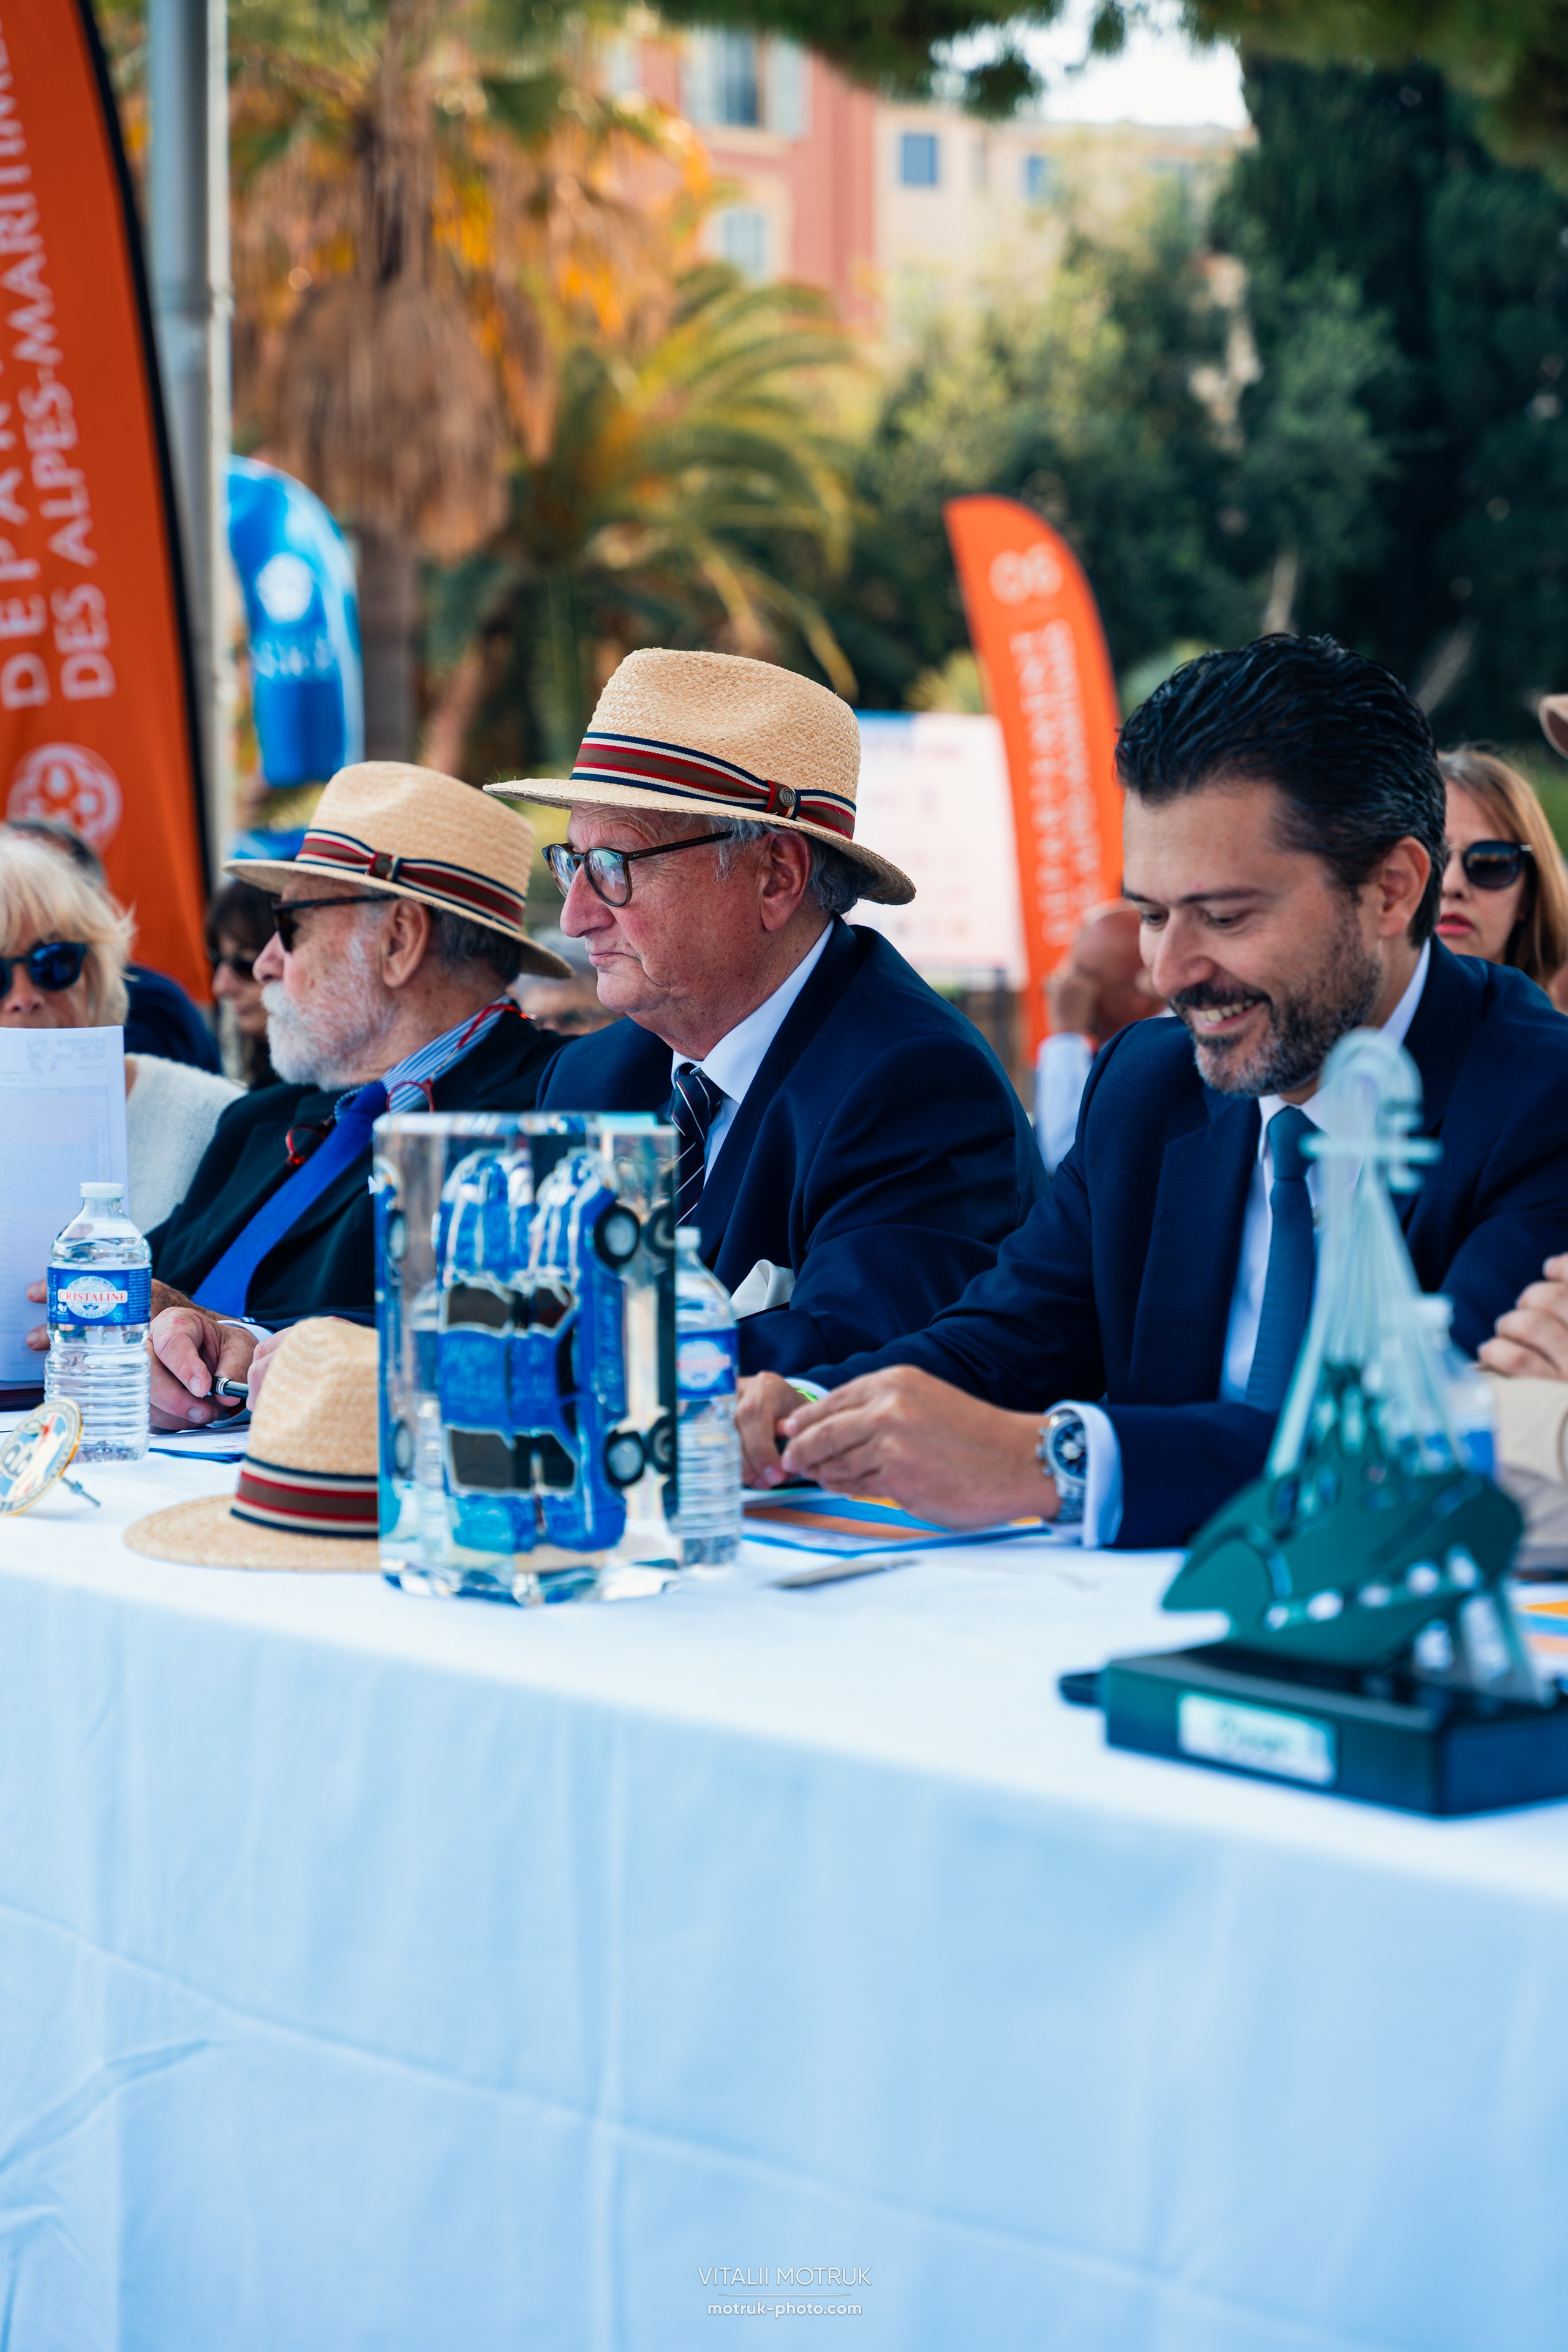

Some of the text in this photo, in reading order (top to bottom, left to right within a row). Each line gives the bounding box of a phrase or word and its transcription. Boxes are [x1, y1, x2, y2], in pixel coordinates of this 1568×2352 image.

[51, 583, 116, 701] DES
[91, 1277, 113, 1289] SOURCE
[59, 1291, 124, 1302] CRISTALINE
